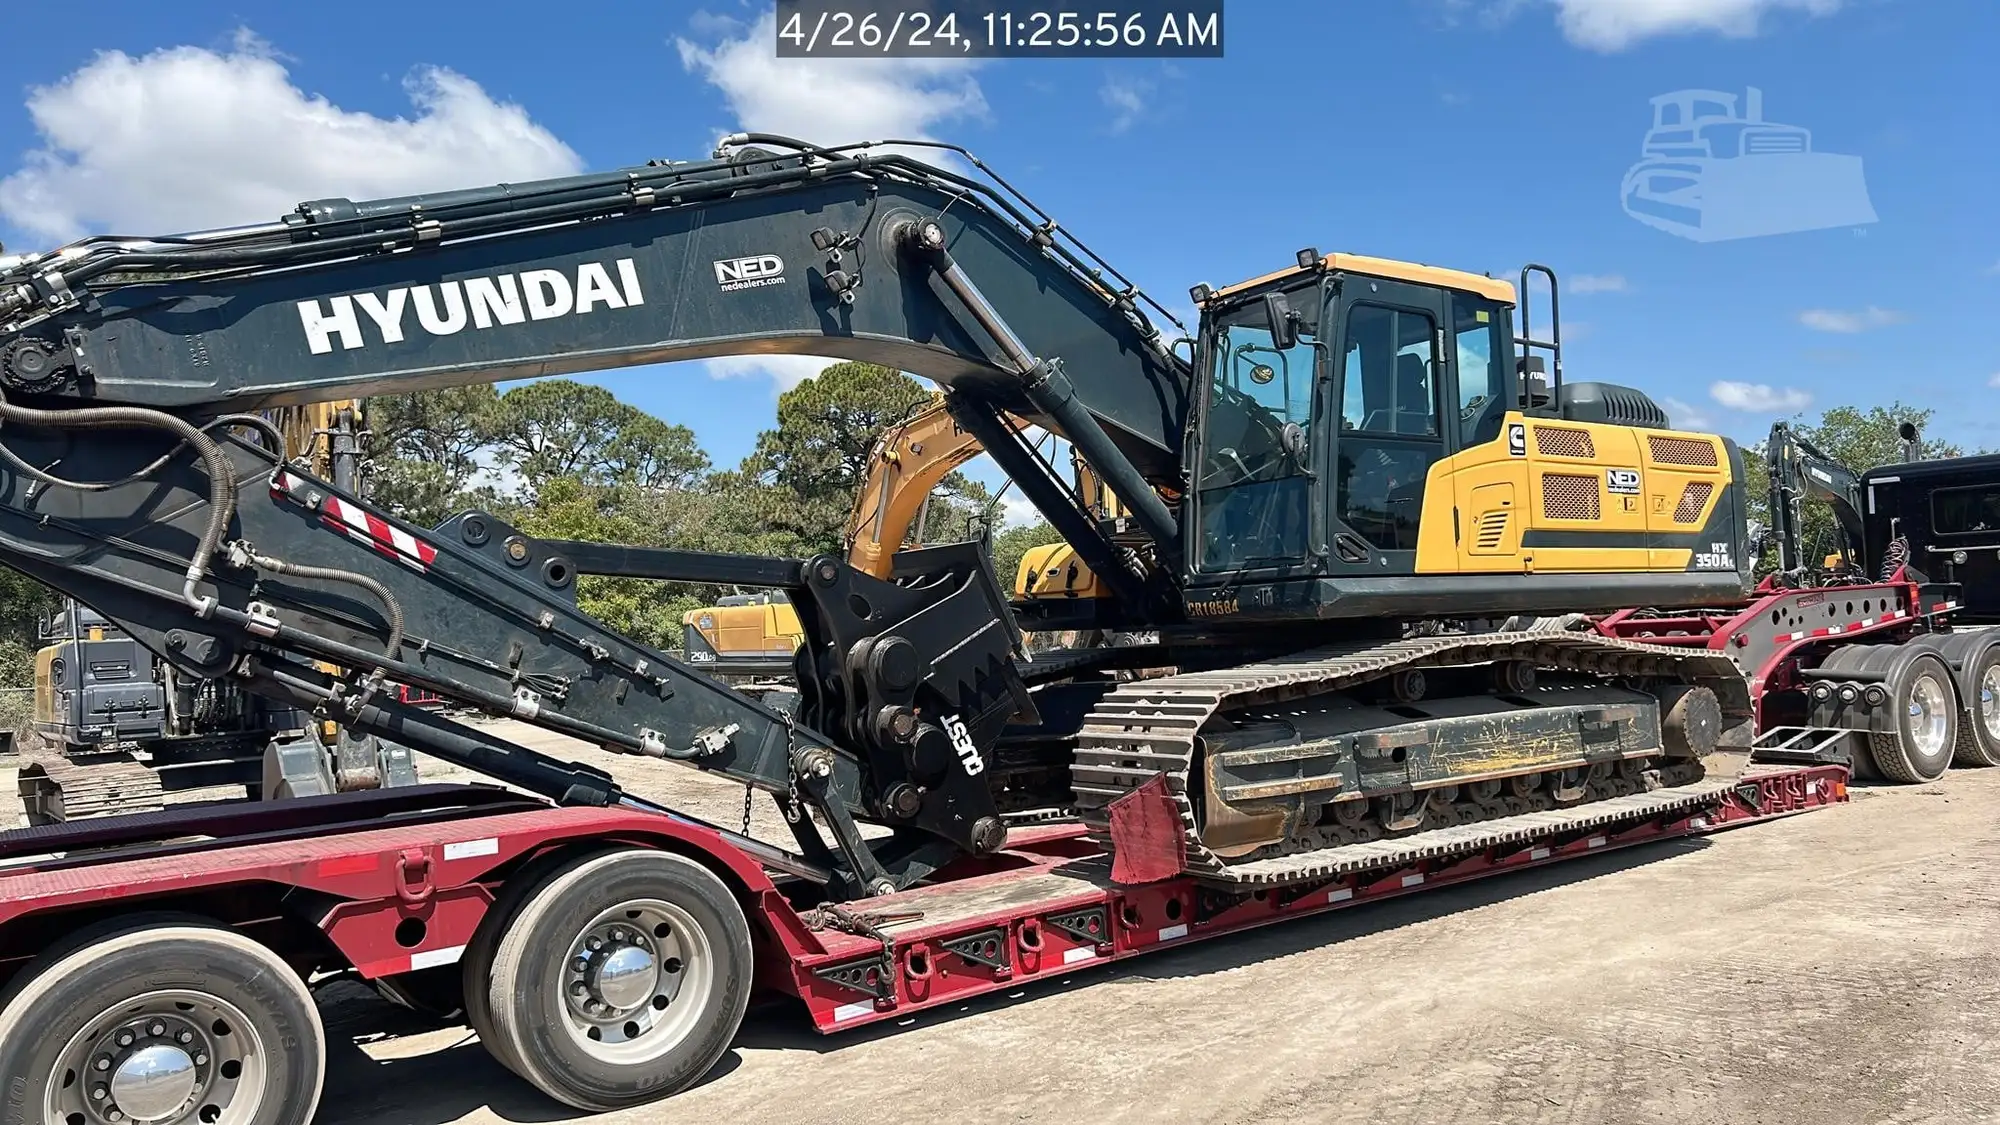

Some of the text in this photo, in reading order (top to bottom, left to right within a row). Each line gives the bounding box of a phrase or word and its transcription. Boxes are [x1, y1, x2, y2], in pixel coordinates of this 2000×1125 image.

[715, 256, 782, 282] NED
[720, 276, 786, 292] nedealers.com
[297, 258, 645, 355] HYUNDAI
[1607, 470, 1640, 486] NED
[1711, 542, 1729, 554] HX
[939, 713, 985, 777] QUEST
